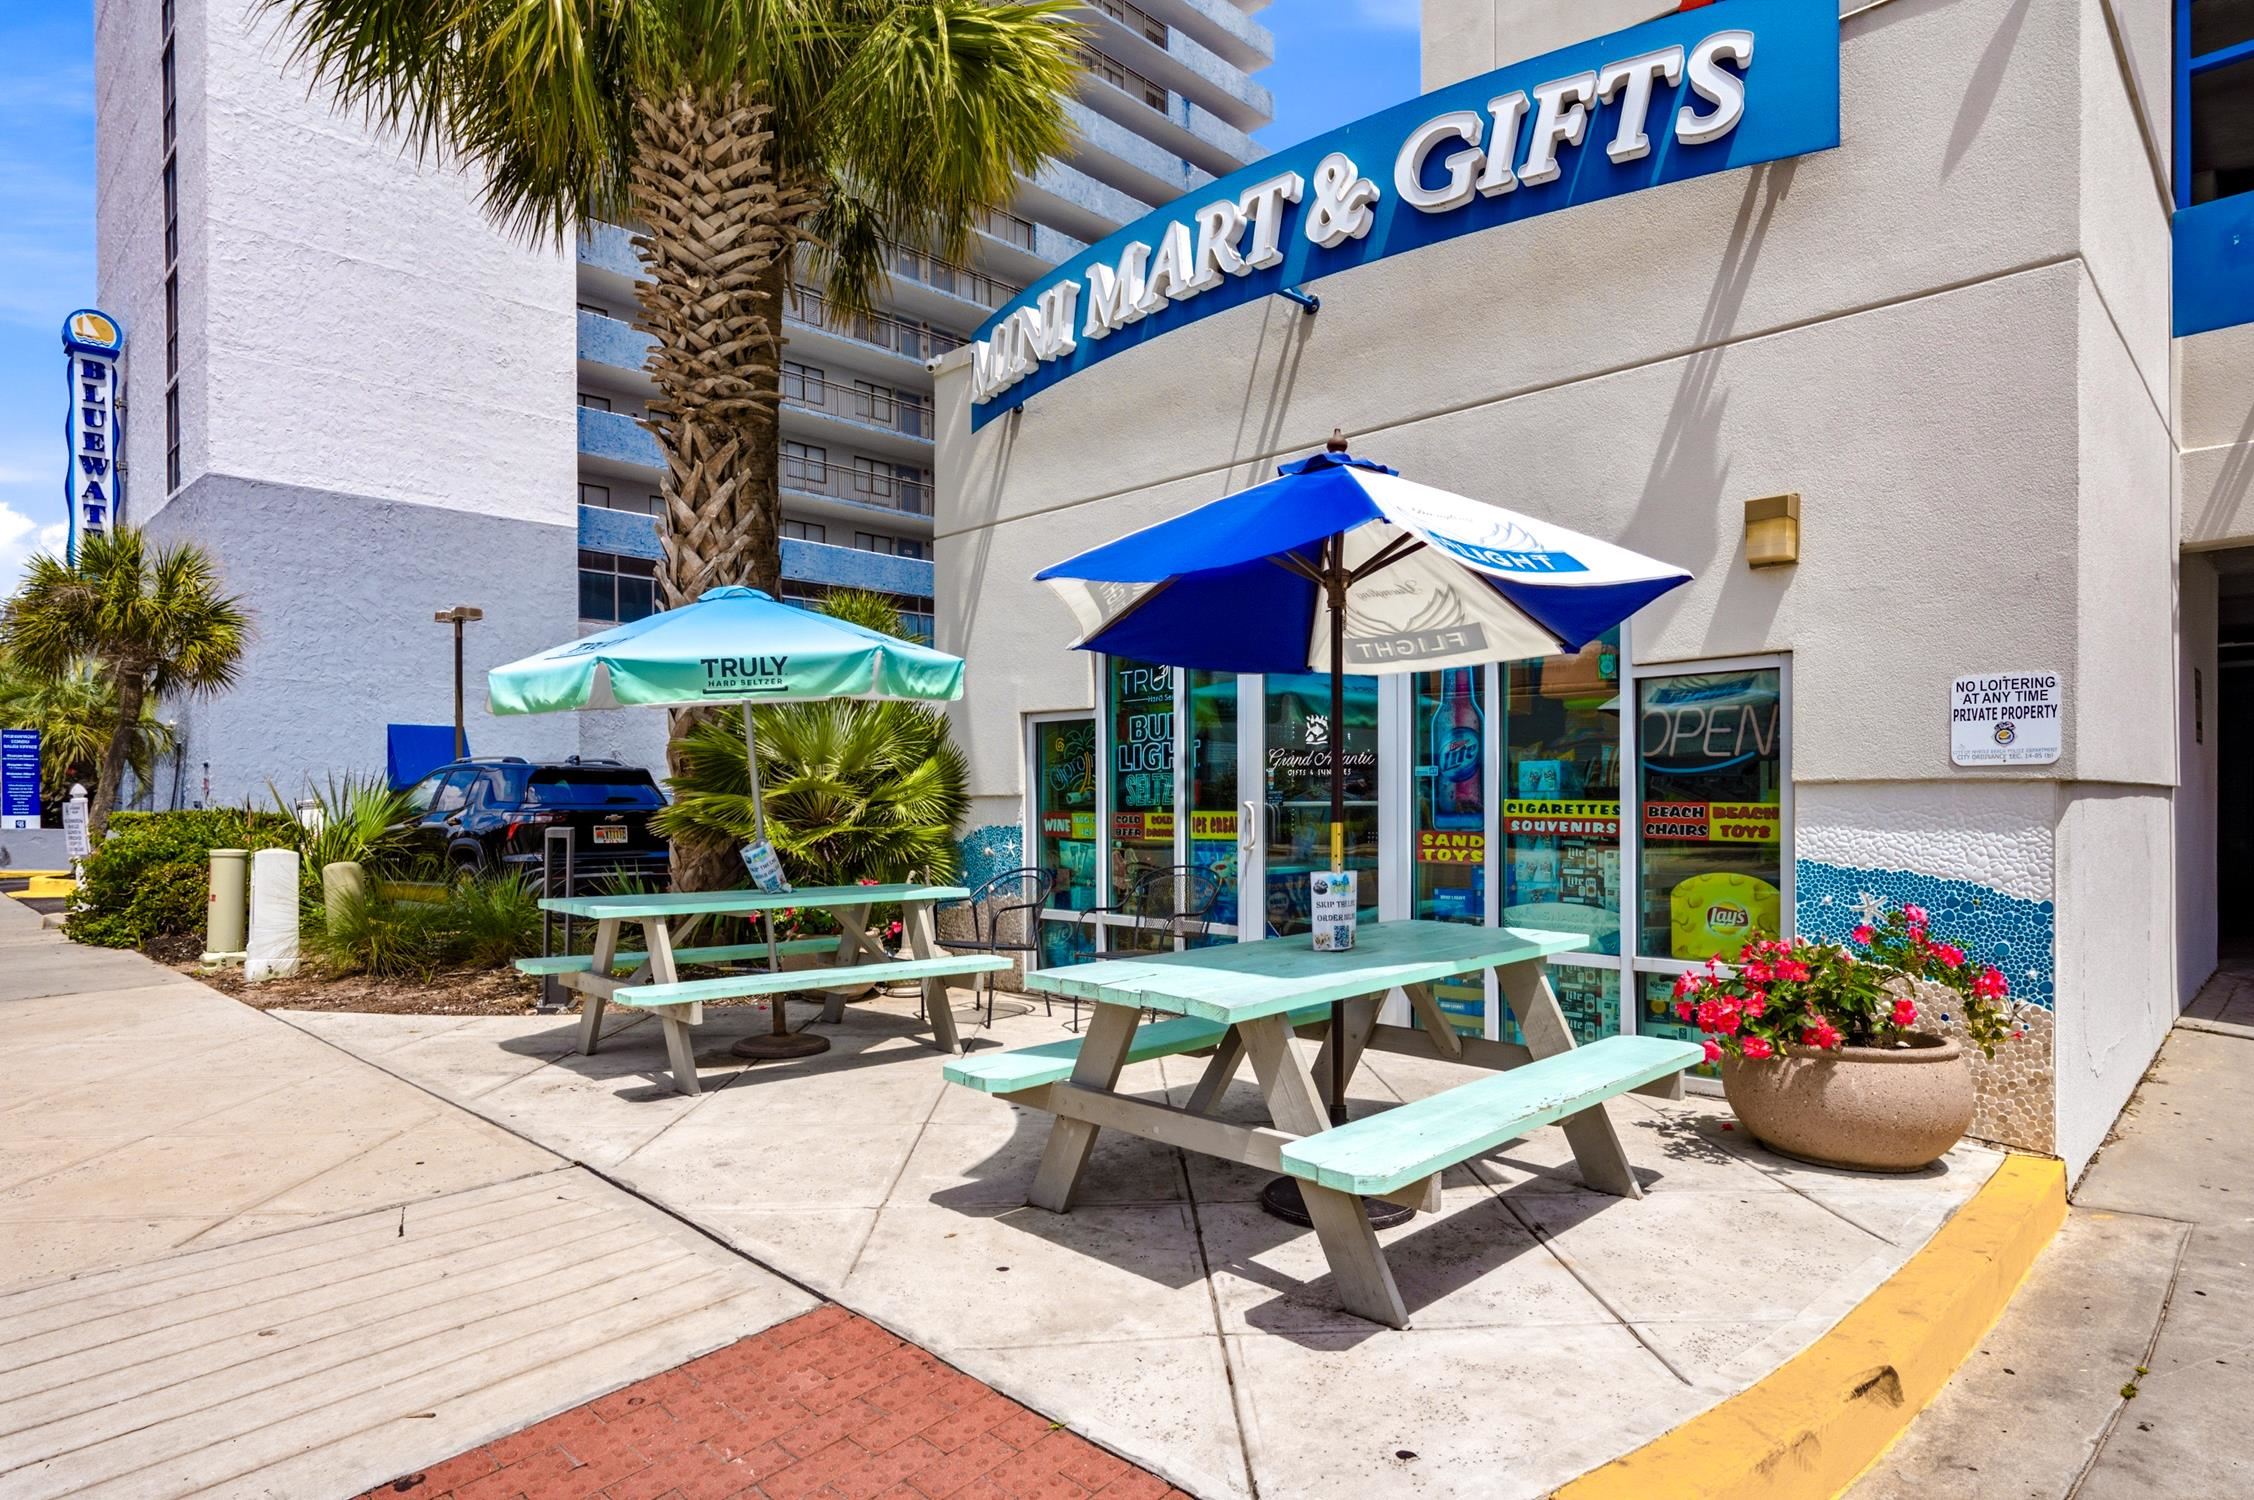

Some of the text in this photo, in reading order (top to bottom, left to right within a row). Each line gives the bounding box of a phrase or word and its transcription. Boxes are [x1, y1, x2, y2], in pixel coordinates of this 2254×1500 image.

[972, 29, 1755, 404] MINI MART & GIFTS
[79, 359, 110, 536] BLUEWAT
[700, 656, 788, 678] TRULY
[708, 678, 783, 688] HARD SELTZER
[1120, 668, 1174, 695] TRUL
[1956, 676, 2056, 693] NO LOITERING
[1962, 689, 2049, 705] AT ANY TIME
[1953, 704, 2058, 722] PRIVATE PROPERTY
[1643, 704, 1779, 757] OPEN
[1268, 748, 1376, 771] Grand Aantic
[1317, 768, 1352, 777] SUNES
[1125, 773, 1174, 807] SELTZ
[1506, 802, 1621, 816] CIGARETTES
[1647, 806, 1705, 818] BEACH
[1712, 806, 1779, 820] BEACH
[1044, 818, 1072, 833] WINE
[1115, 815, 1141, 824] COLD
[1192, 816, 1208, 833] ICE
[1511, 819, 1617, 834] SOUVENIRS
[1115, 828, 1142, 837] BEER
[1645, 823, 1709, 836] CHAIRS
[1720, 824, 1771, 838] TOYS
[1422, 833, 1485, 848] SAND
[1422, 848, 1484, 863] TOYS
[1568, 848, 1585, 860] Lite
[1316, 901, 1335, 909] SKIP
[1316, 914, 1344, 922] ORDER
